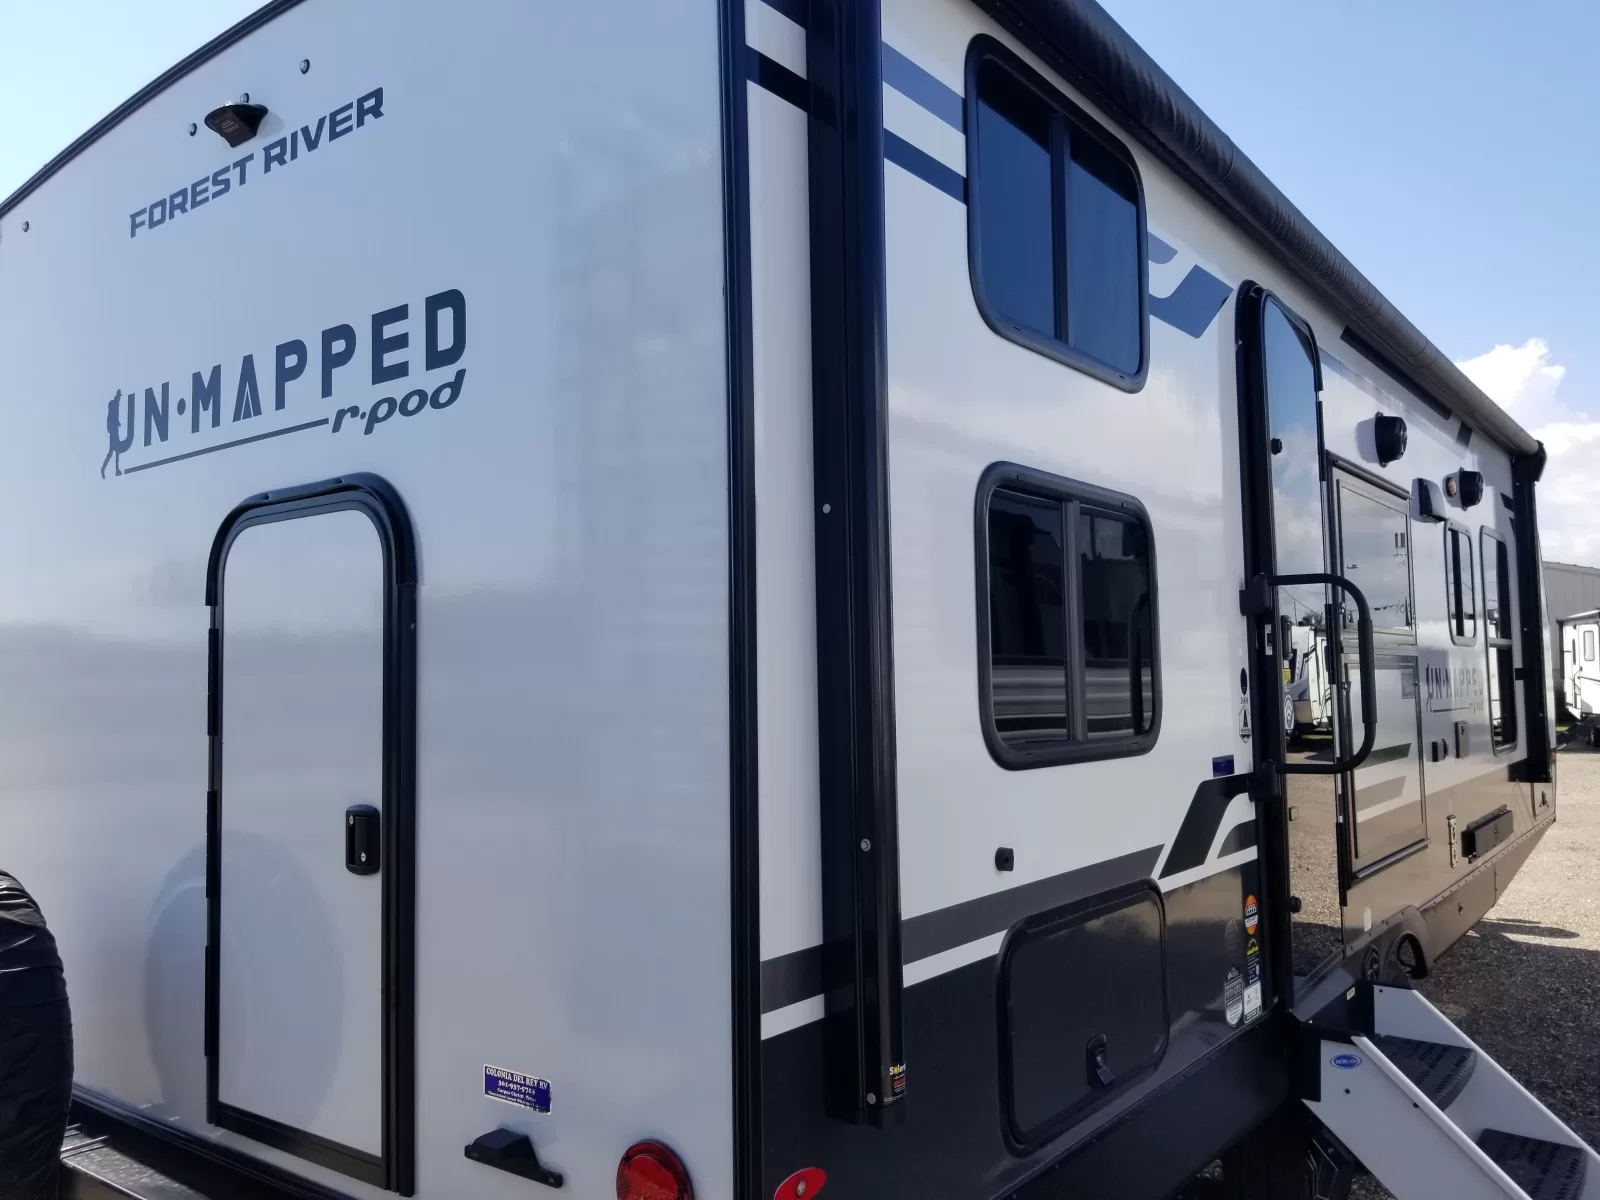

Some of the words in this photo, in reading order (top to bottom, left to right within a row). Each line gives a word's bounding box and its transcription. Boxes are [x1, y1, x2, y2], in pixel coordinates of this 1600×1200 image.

[129, 152, 255, 239] FOREST
[262, 86, 385, 175] RIVER
[486, 1067, 512, 1081] COLONIA
[513, 1074, 525, 1084] DEL
[525, 1077, 539, 1088] REY
